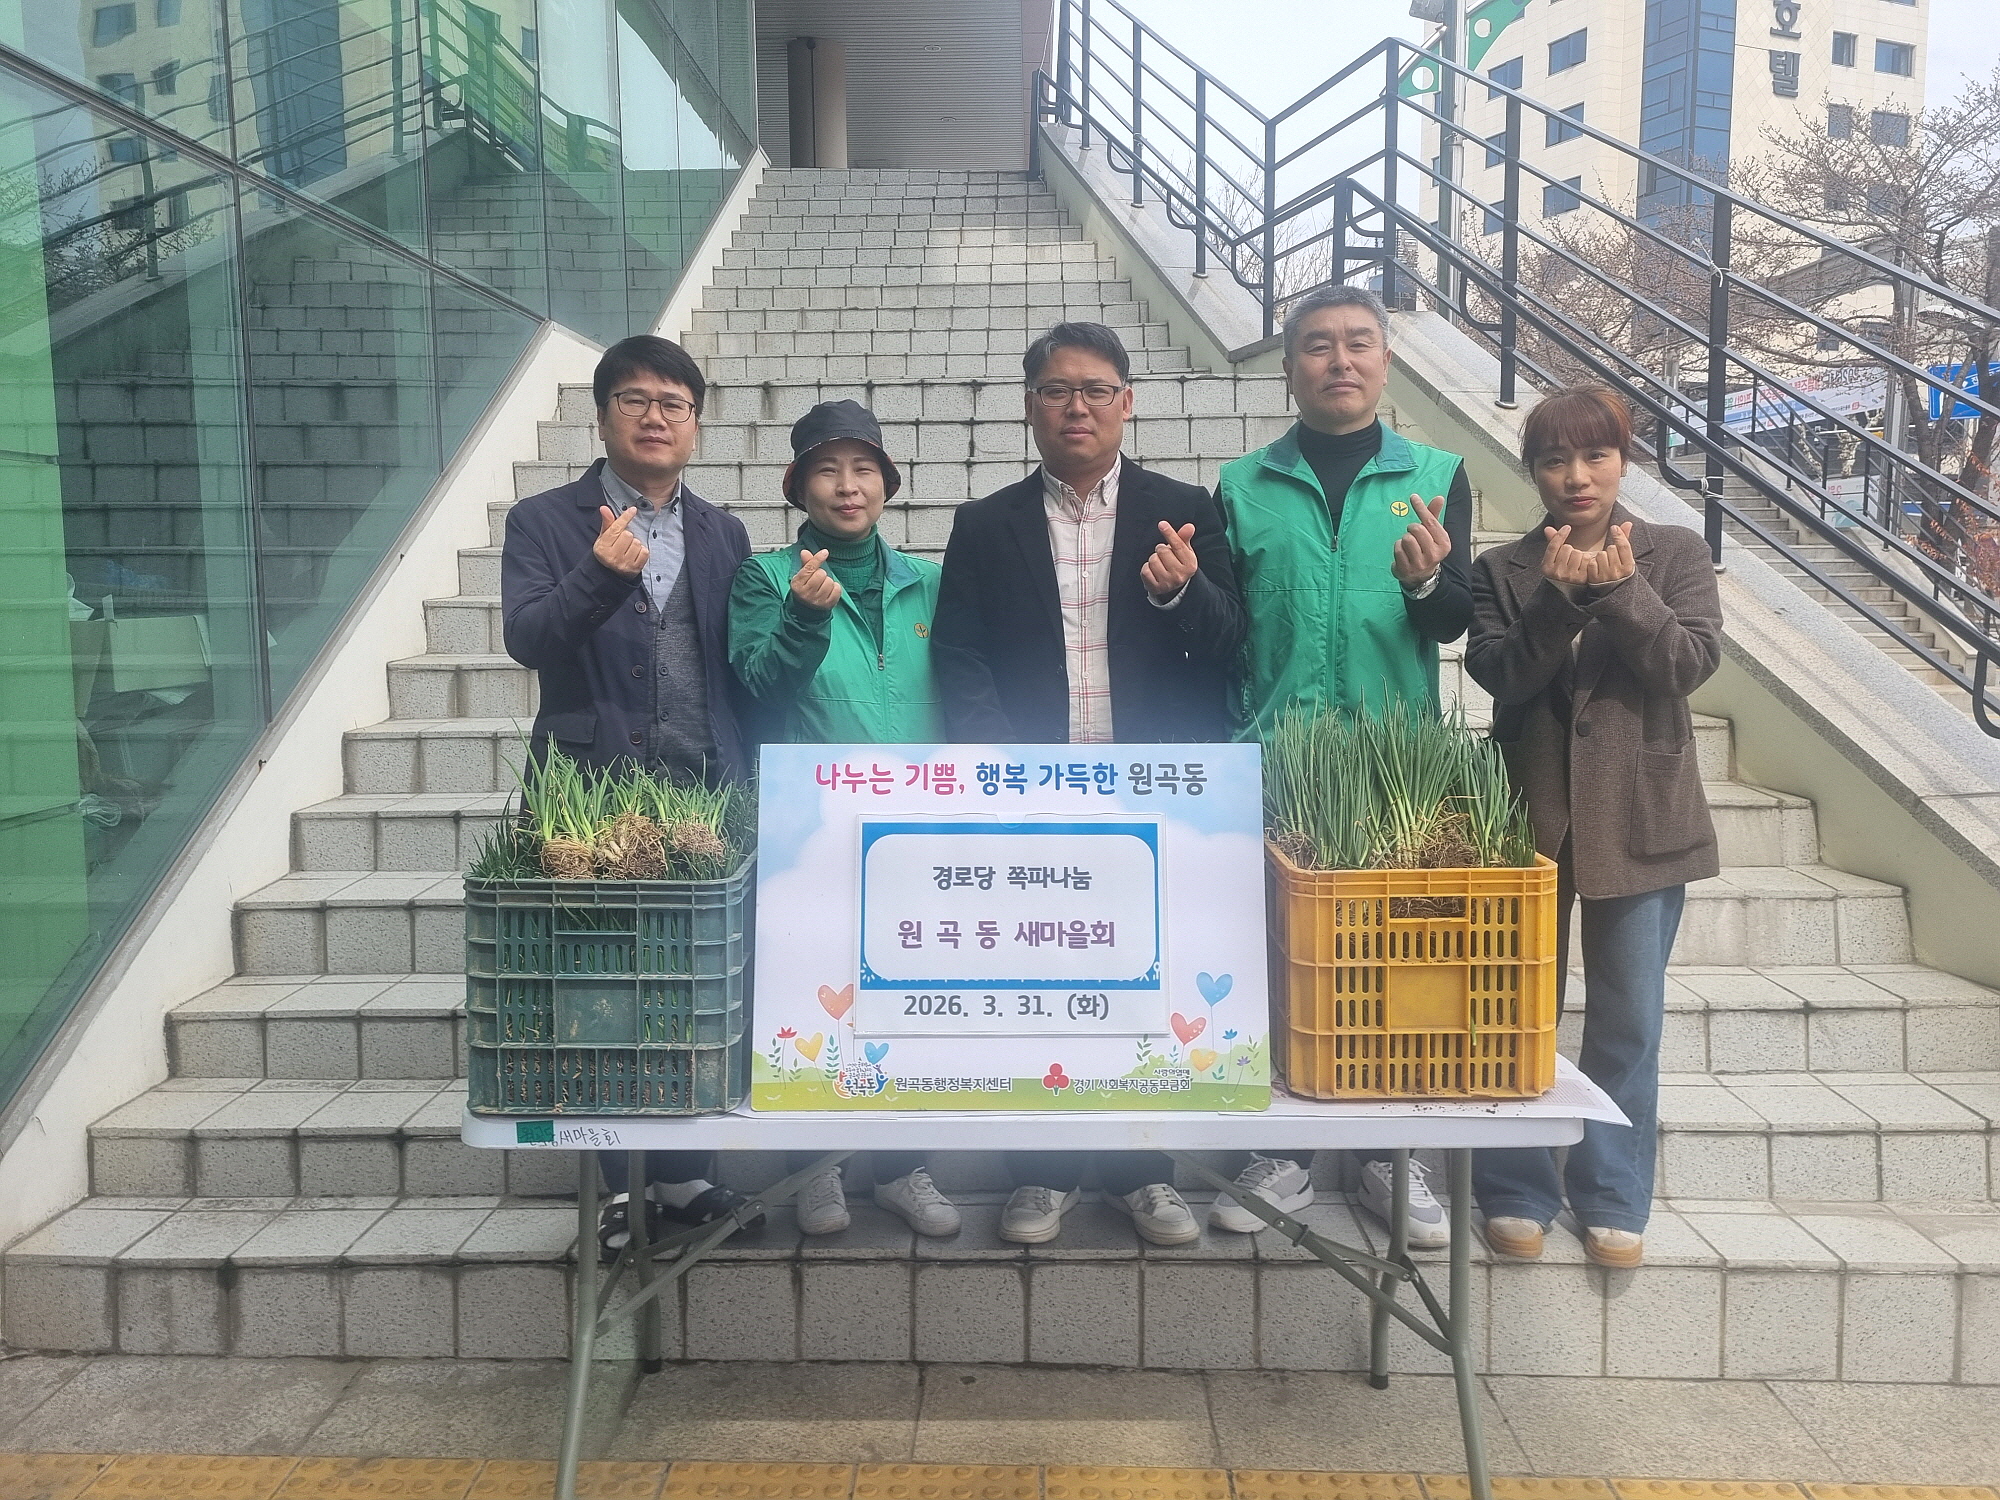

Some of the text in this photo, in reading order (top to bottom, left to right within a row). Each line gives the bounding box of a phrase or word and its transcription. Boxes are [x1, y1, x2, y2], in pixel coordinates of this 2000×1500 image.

[1769, 0, 1802, 98] 호텔
[815, 762, 1208, 796] 나누는 기쁨, 행복 가득한 원곡동
[932, 866, 1093, 891] 경로당 쪽파나눔
[1013, 919, 1115, 950] 새마을회
[903, 992, 1109, 1021] 2026. 3. 31. (화)
[895, 1077, 1012, 1092] 원곡동행정복지센터
